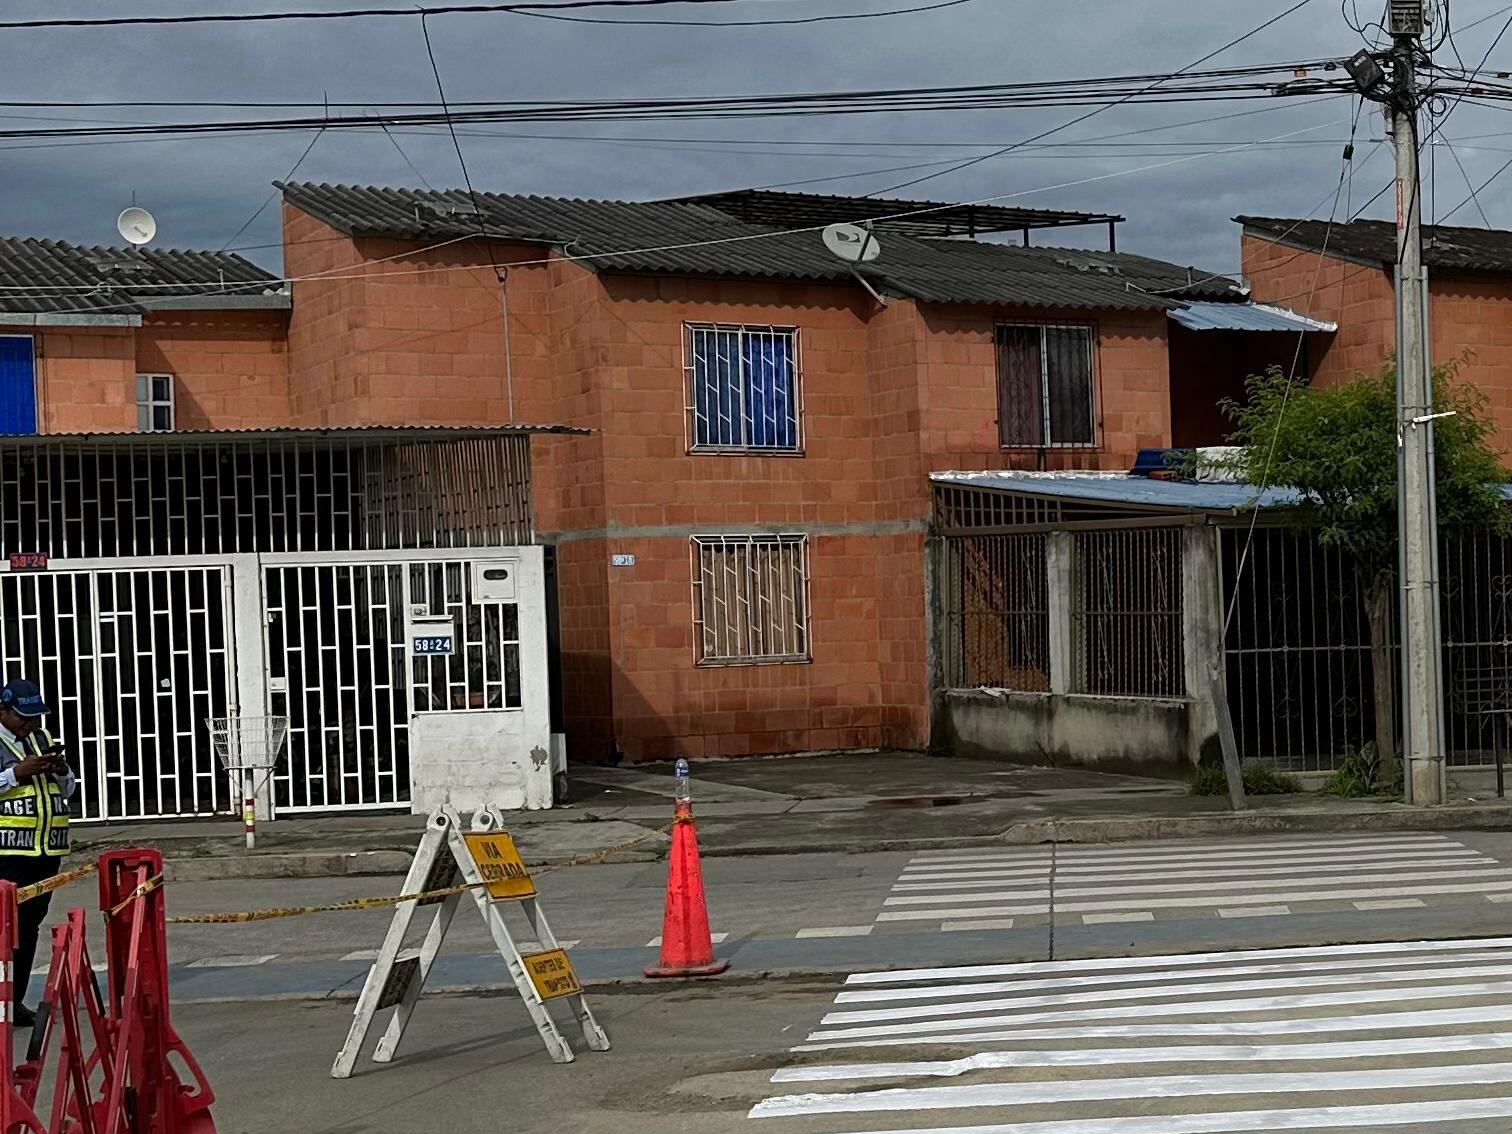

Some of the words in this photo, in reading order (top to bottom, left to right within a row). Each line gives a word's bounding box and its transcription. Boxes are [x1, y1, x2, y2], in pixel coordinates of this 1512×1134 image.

[3, 798, 35, 815] AGE
[0, 829, 34, 847] TRAN
[480, 841, 503, 859] VIA
[480, 862, 527, 881] CERRADA
